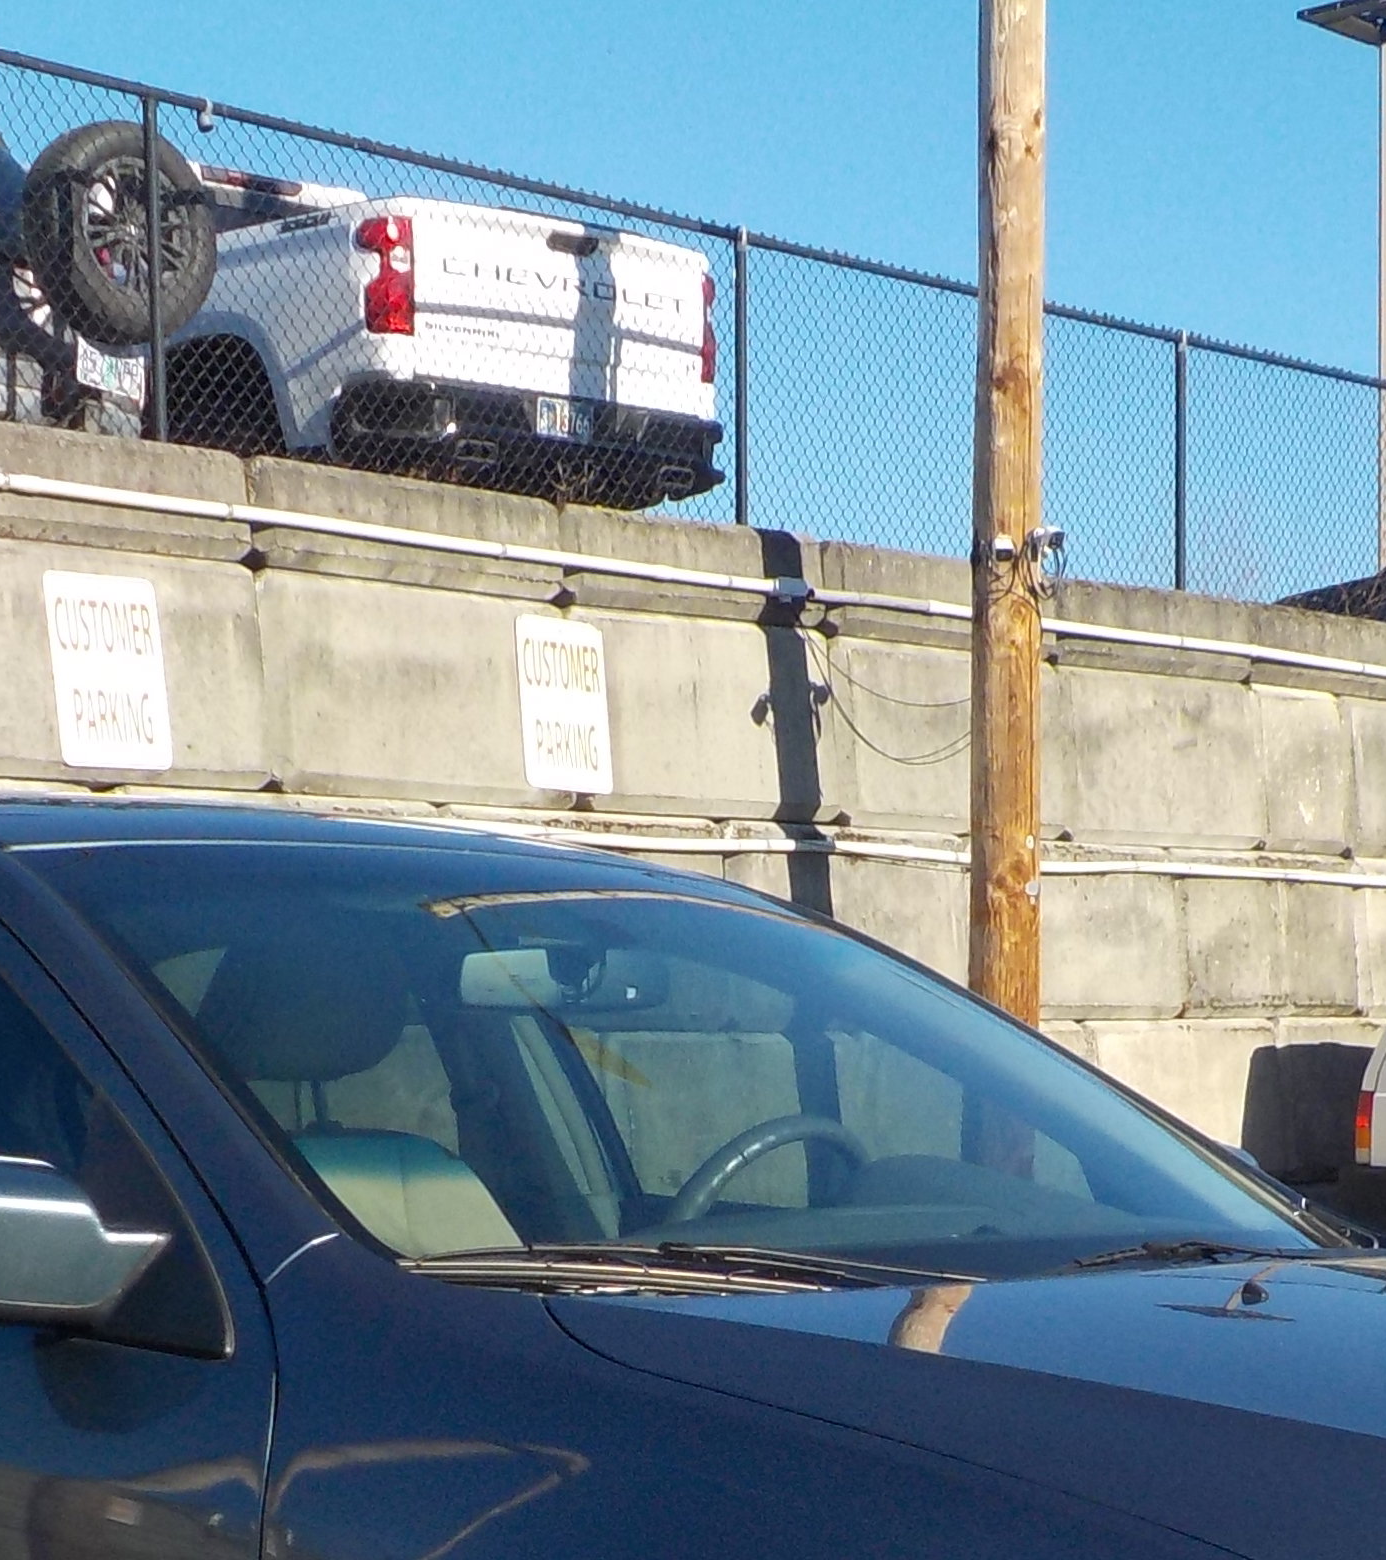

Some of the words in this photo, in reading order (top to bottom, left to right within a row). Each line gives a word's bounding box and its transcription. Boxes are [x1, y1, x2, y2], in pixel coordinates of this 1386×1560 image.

[54, 596, 155, 656] CUSTOMER
[523, 637, 601, 693] CUSTOMER
[73, 688, 154, 744] PARKING
[536, 719, 599, 771] PARKING
